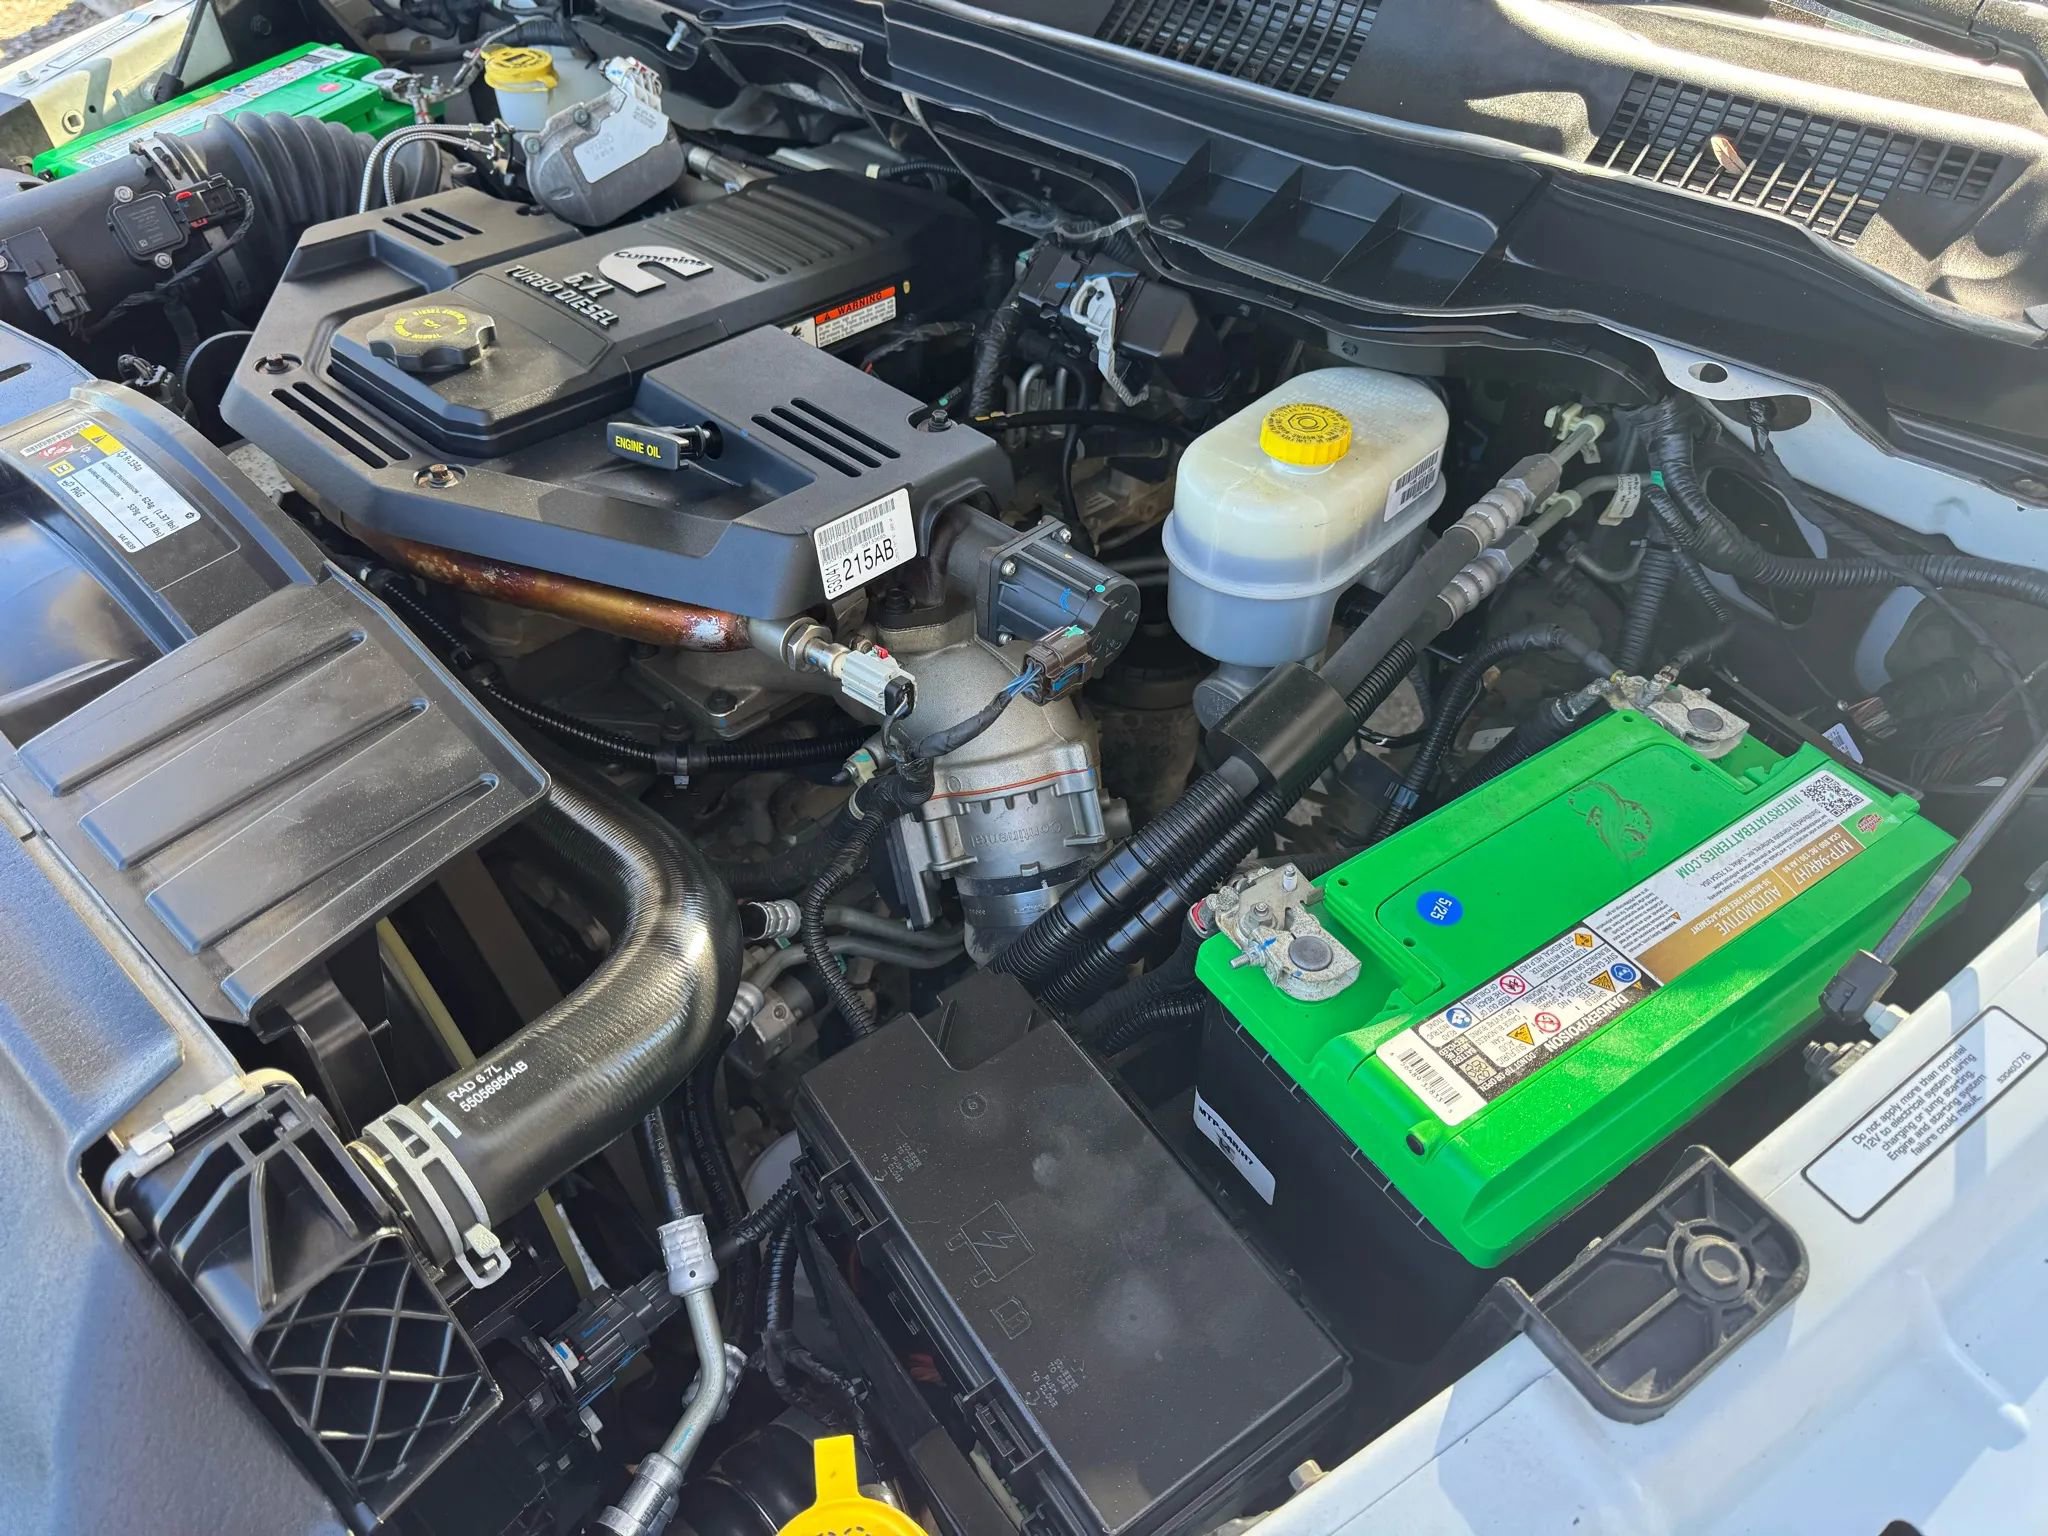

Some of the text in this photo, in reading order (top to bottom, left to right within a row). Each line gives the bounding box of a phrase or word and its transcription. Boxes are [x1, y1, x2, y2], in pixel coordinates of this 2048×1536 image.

[614, 250, 706, 266] Cummins
[563, 271, 615, 298] 6.7L
[504, 264, 620, 328] TURBO DIESEL
[836, 291, 883, 316] WARNING
[615, 435, 662, 459] ENGINE OIL
[122, 454, 143, 472] R-134a
[70, 486, 85, 497] PAG
[127, 503, 140, 515] 539g
[138, 515, 155, 528] (1.19
[141, 496, 154, 509] 624g
[153, 508, 169, 521] (1.37
[841, 537, 895, 582] 215AB
[968, 818, 1064, 848] Continental
[1676, 795, 1802, 878] INTERSTATEBATTERIES.COM
[1827, 832, 1840, 841] CCA
[1791, 838, 1853, 884] MTP-94R/H7
[1429, 896, 1452, 920] 5/25
[1714, 885, 1781, 936] AUTOMOTIVE
[1727, 896, 1743, 908] FREE
[1690, 904, 1731, 934] REPLACEMENT
[1541, 942, 1565, 958] MEDICAL
[1560, 944, 1574, 956] ATELY
[1563, 936, 1573, 944] GET
[1530, 955, 1544, 965] HELP
[1546, 954, 1560, 964] WITH
[1558, 956, 1572, 966] EYES
[1570, 948, 1587, 959] FLUSH
[1582, 946, 1611, 966] BLINDNESS
[1557, 952, 1617, 993] SIVE GASES CAN CAUSE
[1474, 990, 1504, 1010] THE REACH
[1521, 985, 1547, 1003] SMOKING
[1530, 990, 1554, 1007] FLAMES
[1557, 999, 1568, 1009] NO
[1583, 989, 1608, 1007] SHIELD
[1479, 995, 1510, 1017] KEEP OUT OF
[1475, 1014, 1520, 1045] CAUSE BLINDNESS
[1544, 993, 1628, 1052] DANGER/POISON
[1438, 1035, 1467, 1056] RECYCLED
[1491, 1035, 1504, 1045] CAN
[1498, 1040, 1514, 1051] ACID
[1445, 1043, 1469, 1060] MUST BE
[1450, 1046, 1477, 1065] BATTERY
[1495, 1042, 1527, 1064] SULFURIC
[1525, 1052, 1536, 1061] DO
[1504, 1066, 1515, 1075] TIP
[1514, 1058, 1527, 1068] NOT
[1996, 1050, 2031, 1083] 53040076
[446, 1063, 504, 1103] RAD 6.7L
[458, 1059, 529, 1113] 55056954AB
[1494, 1072, 1505, 1081] OR
[1851, 1044, 1967, 1144] Do not apply more than nominal
[1862, 1053, 1977, 1149] 12V to electrical system during
[1881, 1070, 1975, 1151] charging or jump starting.
[1886, 1073, 1986, 1161] Engine and starting system
[1909, 1094, 1982, 1156] failure could result.
[1047, 1361, 1056, 1373] TO
[1054, 1358, 1077, 1389] SQUEEZE
[1031, 1370, 1057, 1407] TO CLOSE
[1042, 1374, 1057, 1394] PUSH
